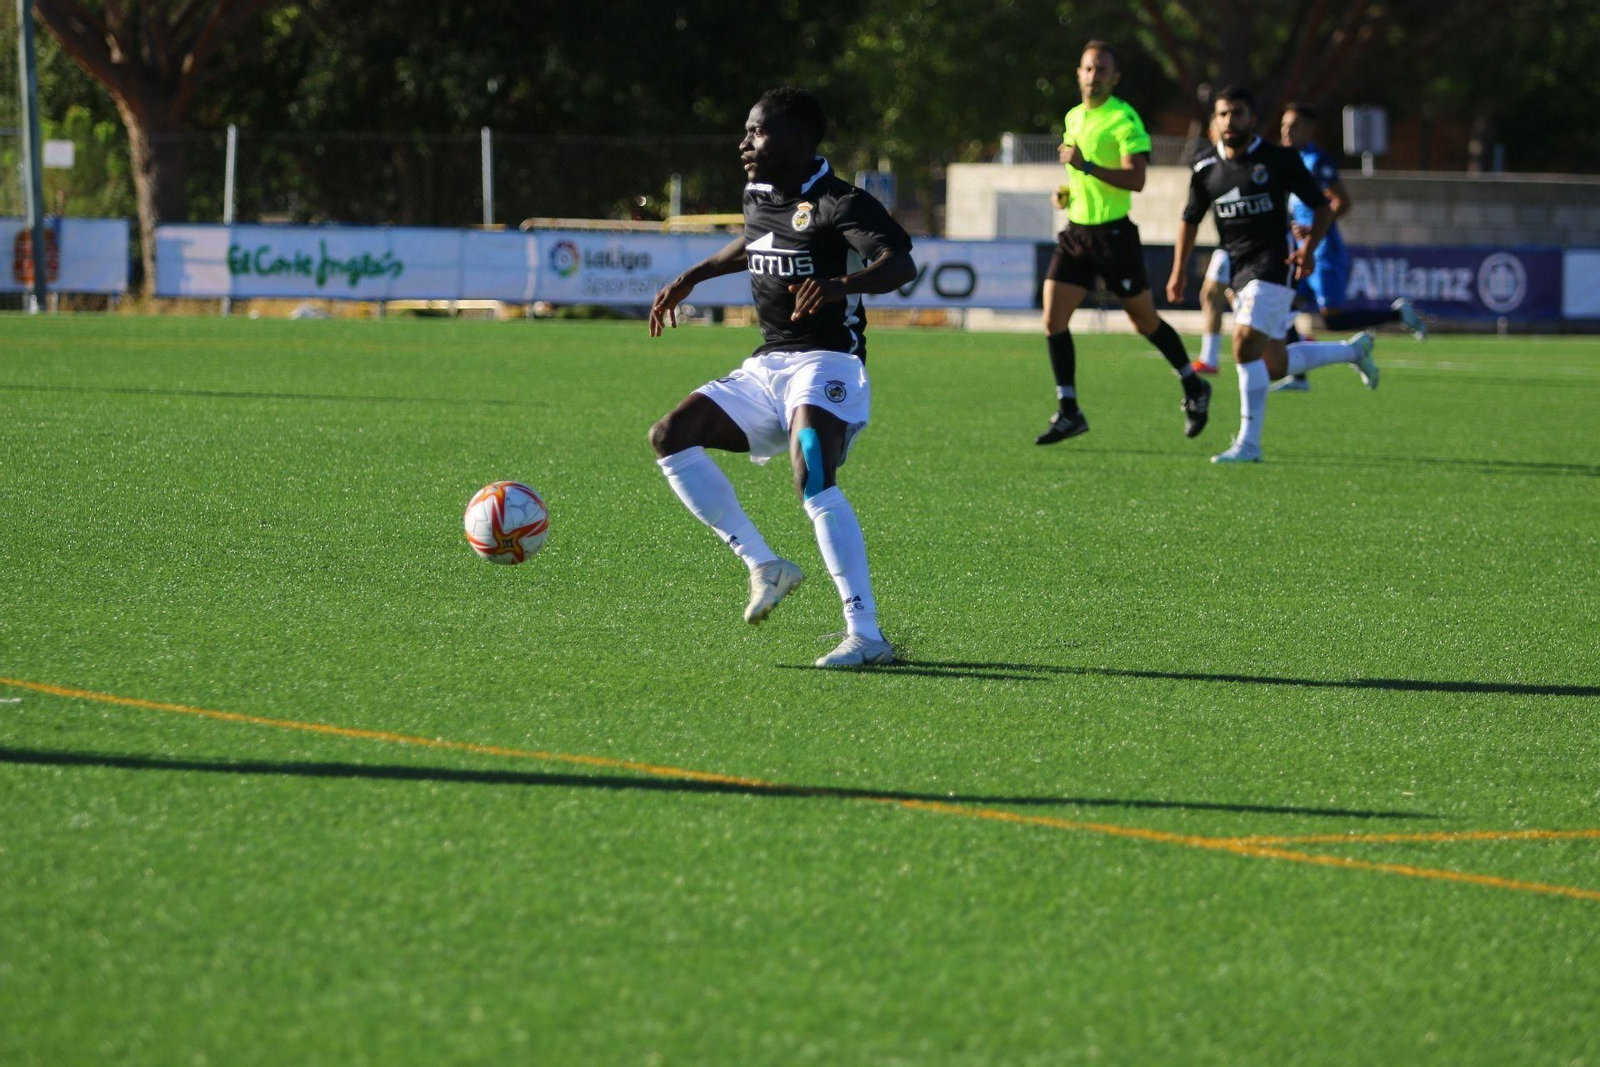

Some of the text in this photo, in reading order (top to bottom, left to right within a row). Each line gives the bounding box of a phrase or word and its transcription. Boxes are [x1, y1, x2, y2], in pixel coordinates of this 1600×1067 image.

[227, 239, 404, 288] El Corte Inglés
[747, 253, 815, 276] LOTUS
[1347, 257, 1474, 301] Allianz
